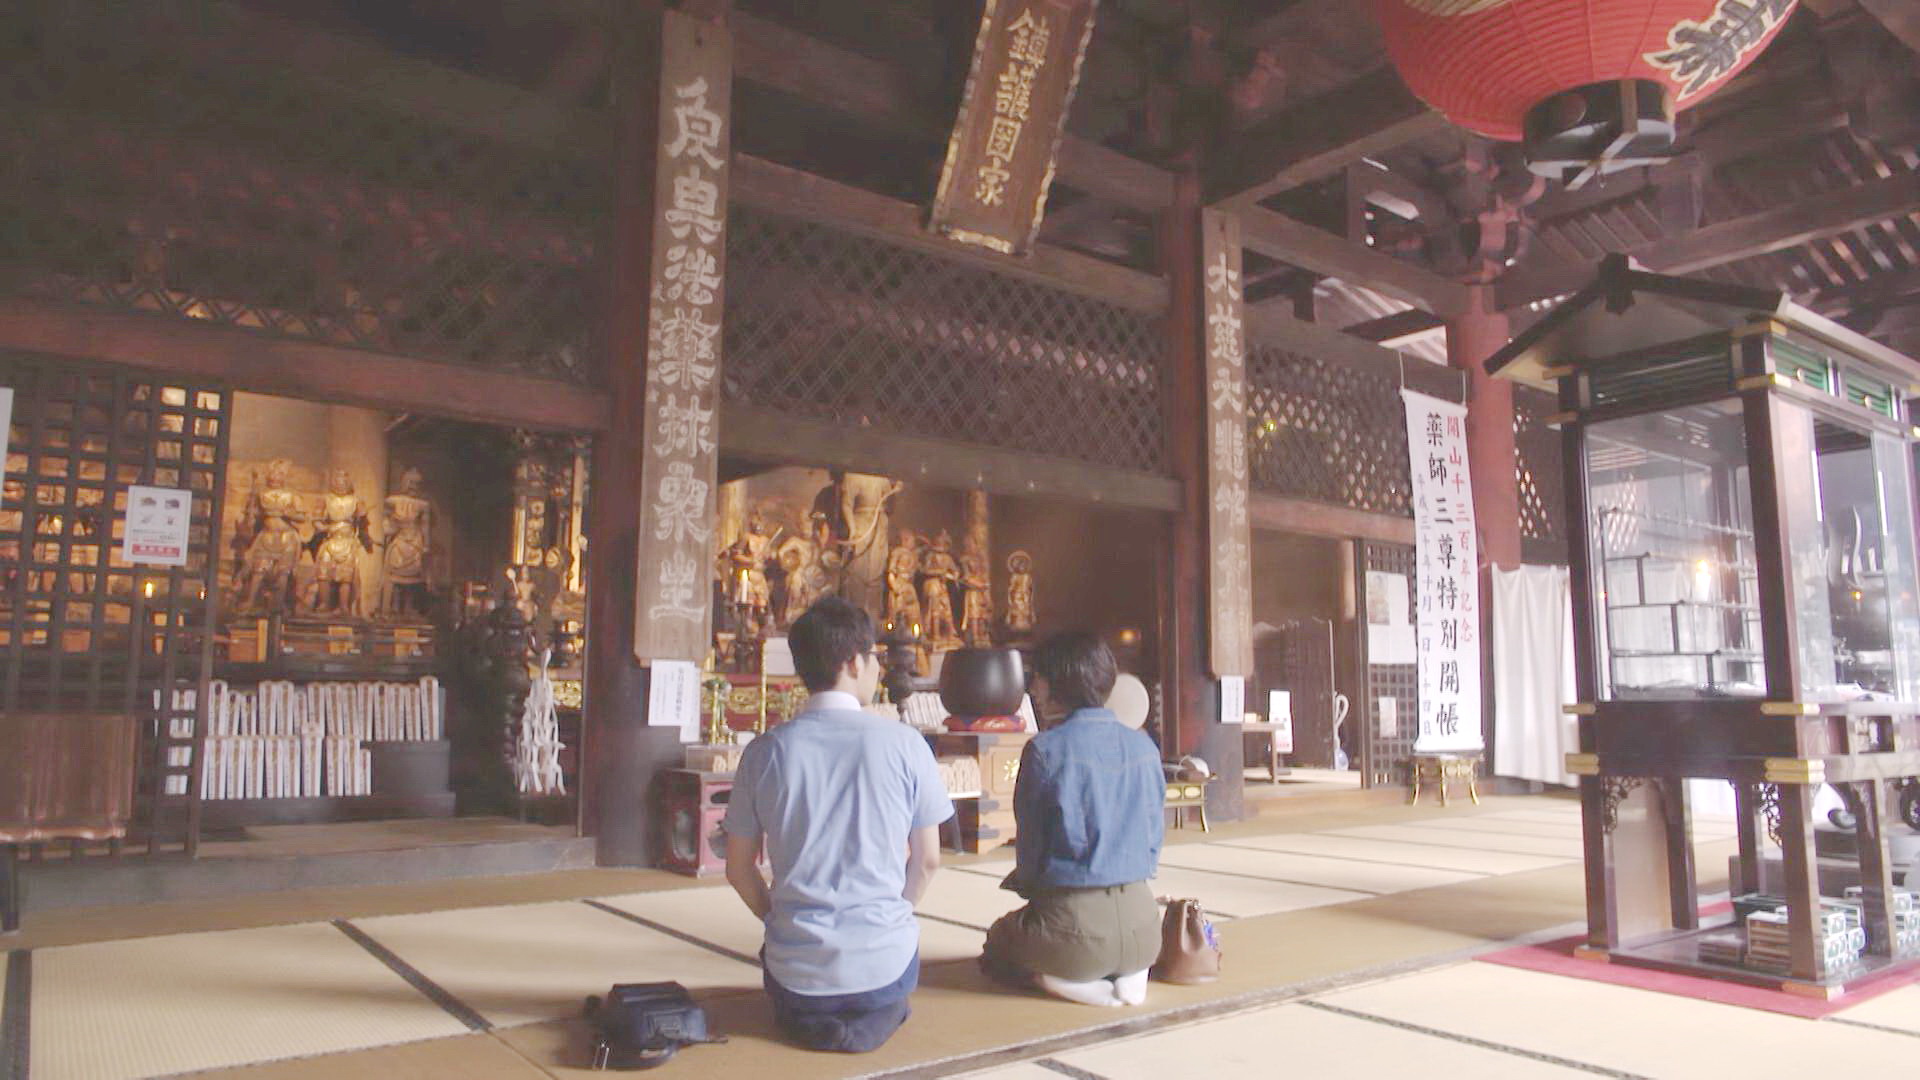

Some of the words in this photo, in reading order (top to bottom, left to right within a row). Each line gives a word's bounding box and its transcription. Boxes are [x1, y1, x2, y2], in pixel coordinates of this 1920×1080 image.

[1426, 411, 1459, 736] 薬師三尊特別開帳
